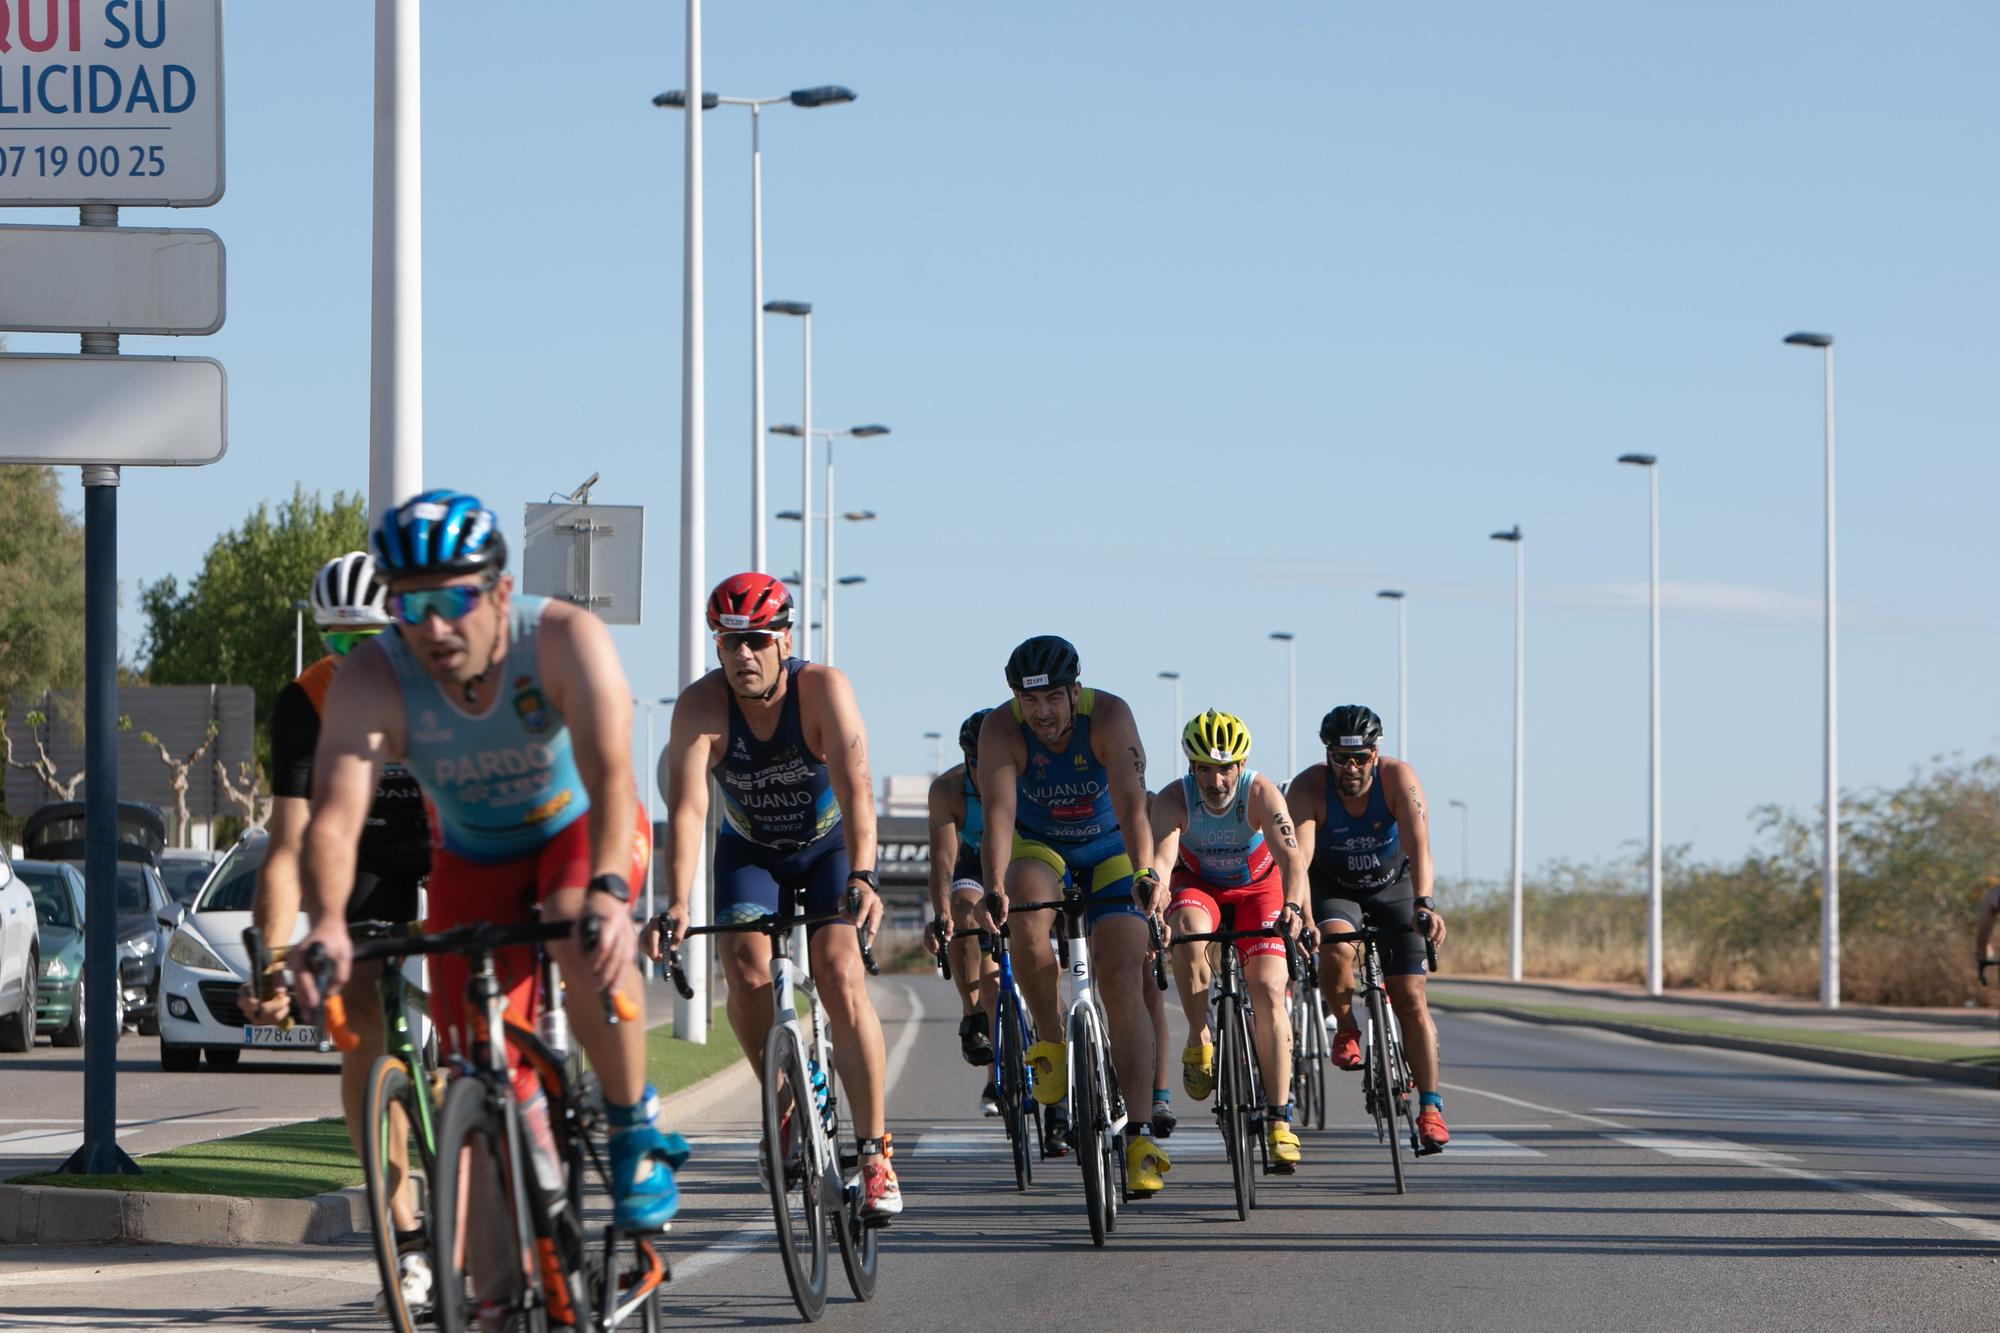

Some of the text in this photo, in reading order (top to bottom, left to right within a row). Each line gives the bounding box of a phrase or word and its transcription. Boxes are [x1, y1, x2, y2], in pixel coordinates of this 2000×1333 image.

[0, 0, 166, 53] UI SU
[0, 64, 196, 114] LICIDAD
[35, 146, 68, 177] 19
[78, 145, 120, 177] 00
[129, 145, 165, 177] 25
[435, 743, 555, 786] PARDO
[741, 791, 812, 808] JUANJO
[1032, 781, 1099, 799] JUANJO
[1348, 853, 1381, 871] BUDA
[253, 1027, 292, 1042] 7784
